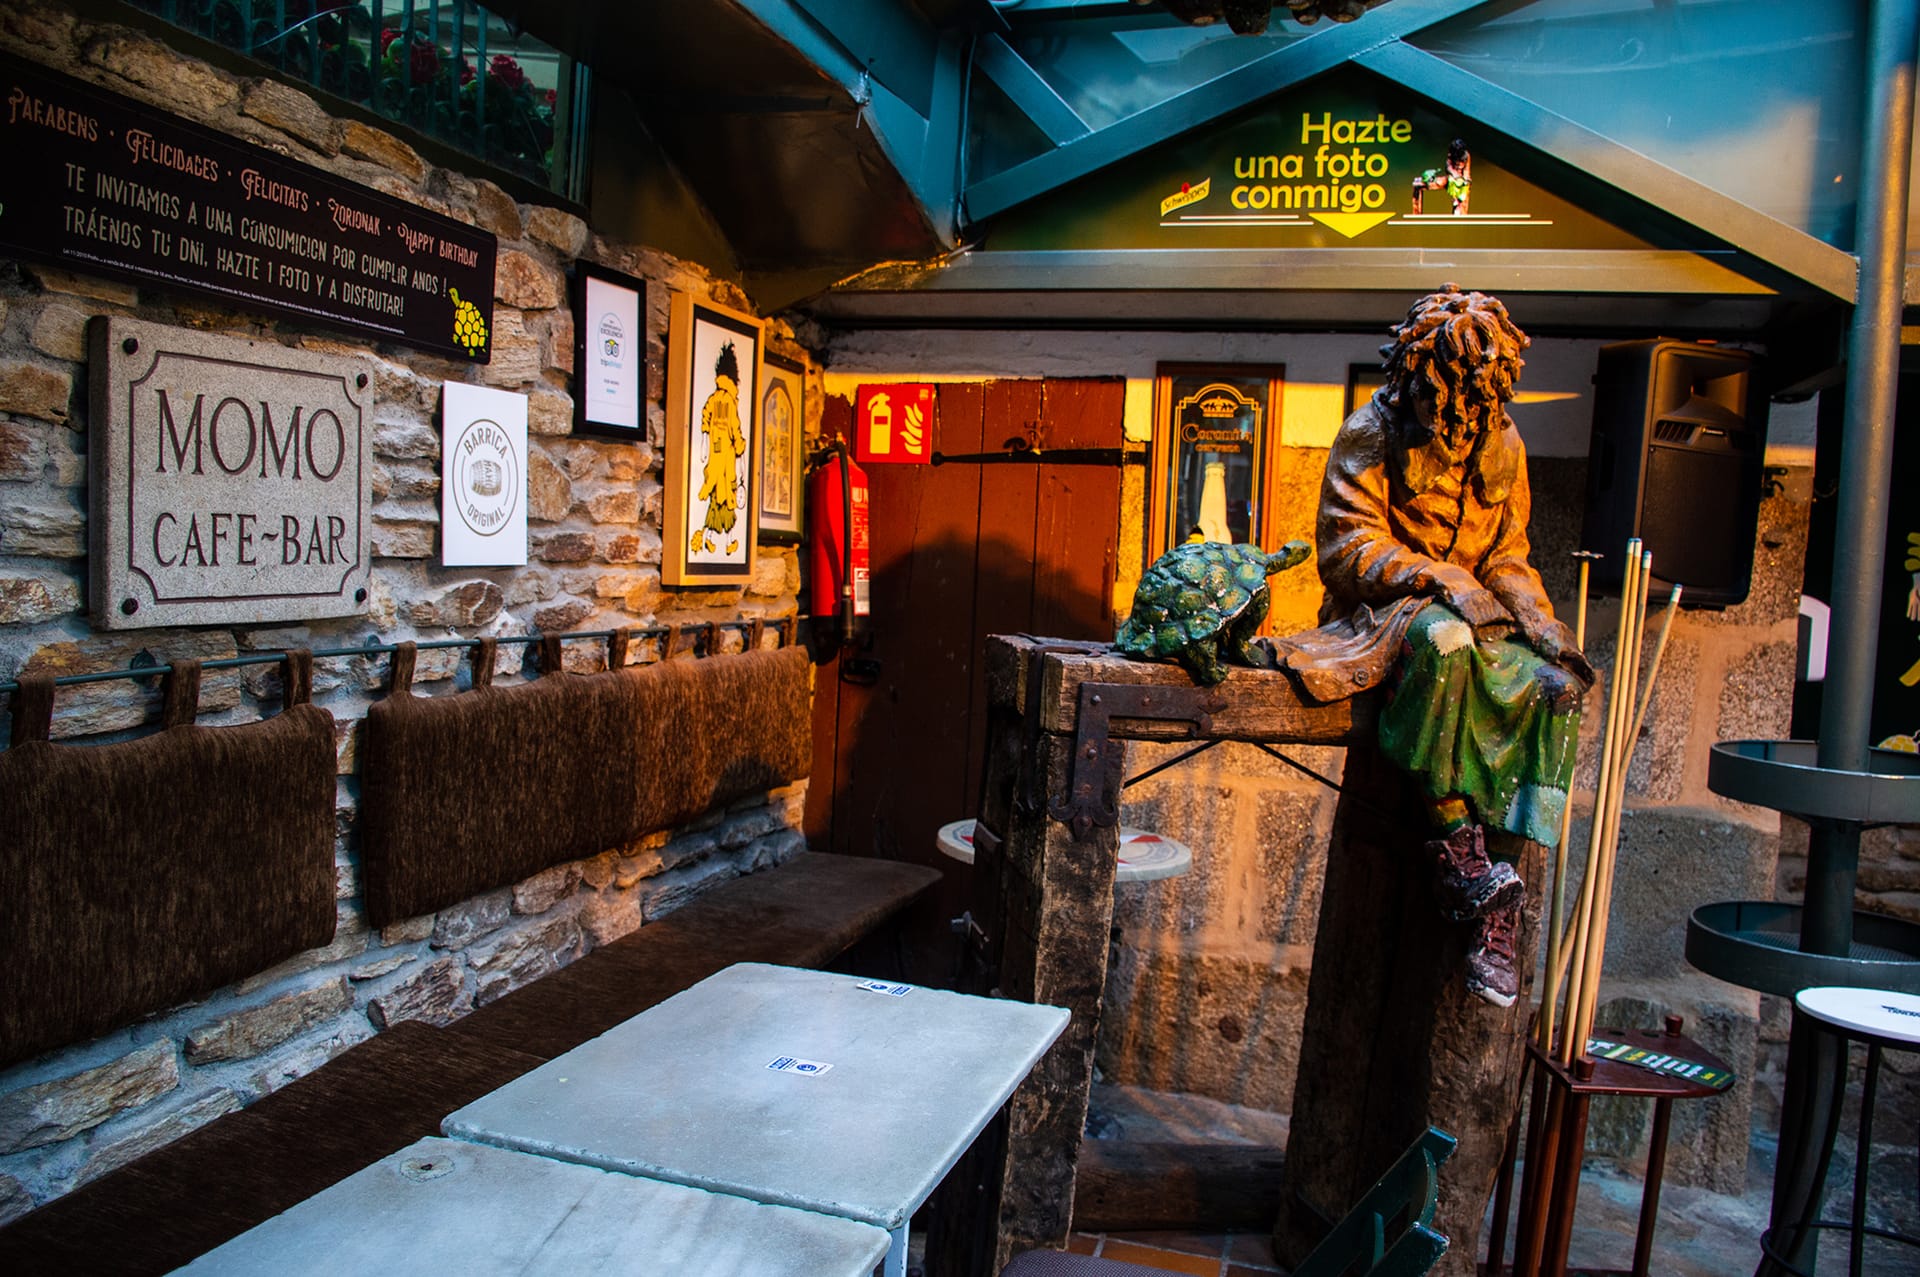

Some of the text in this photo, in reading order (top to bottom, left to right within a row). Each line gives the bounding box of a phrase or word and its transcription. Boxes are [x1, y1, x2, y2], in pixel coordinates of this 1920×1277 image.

[1301, 112, 1412, 145] Hazte
[1234, 144, 1389, 179] una foto
[1231, 178, 1386, 213] conmigo
[65, 163, 86, 193] TE
[96, 172, 180, 220] INVITAMOS
[187, 201, 198, 226] A
[205, 206, 233, 236] UNA
[333, 245, 356, 270] POR
[361, 254, 408, 286] CUMPLIR
[216, 247, 260, 280] HAZTE
[267, 261, 273, 283] 1
[279, 265, 310, 293] FOTO
[316, 274, 325, 296] Y
[328, 279, 337, 300] A
[342, 281, 404, 318] DISFRUTAR!
[154, 389, 345, 482] MOMO
[463, 427, 508, 460] BARRICA
[466, 503, 505, 528] ORIGINAL
